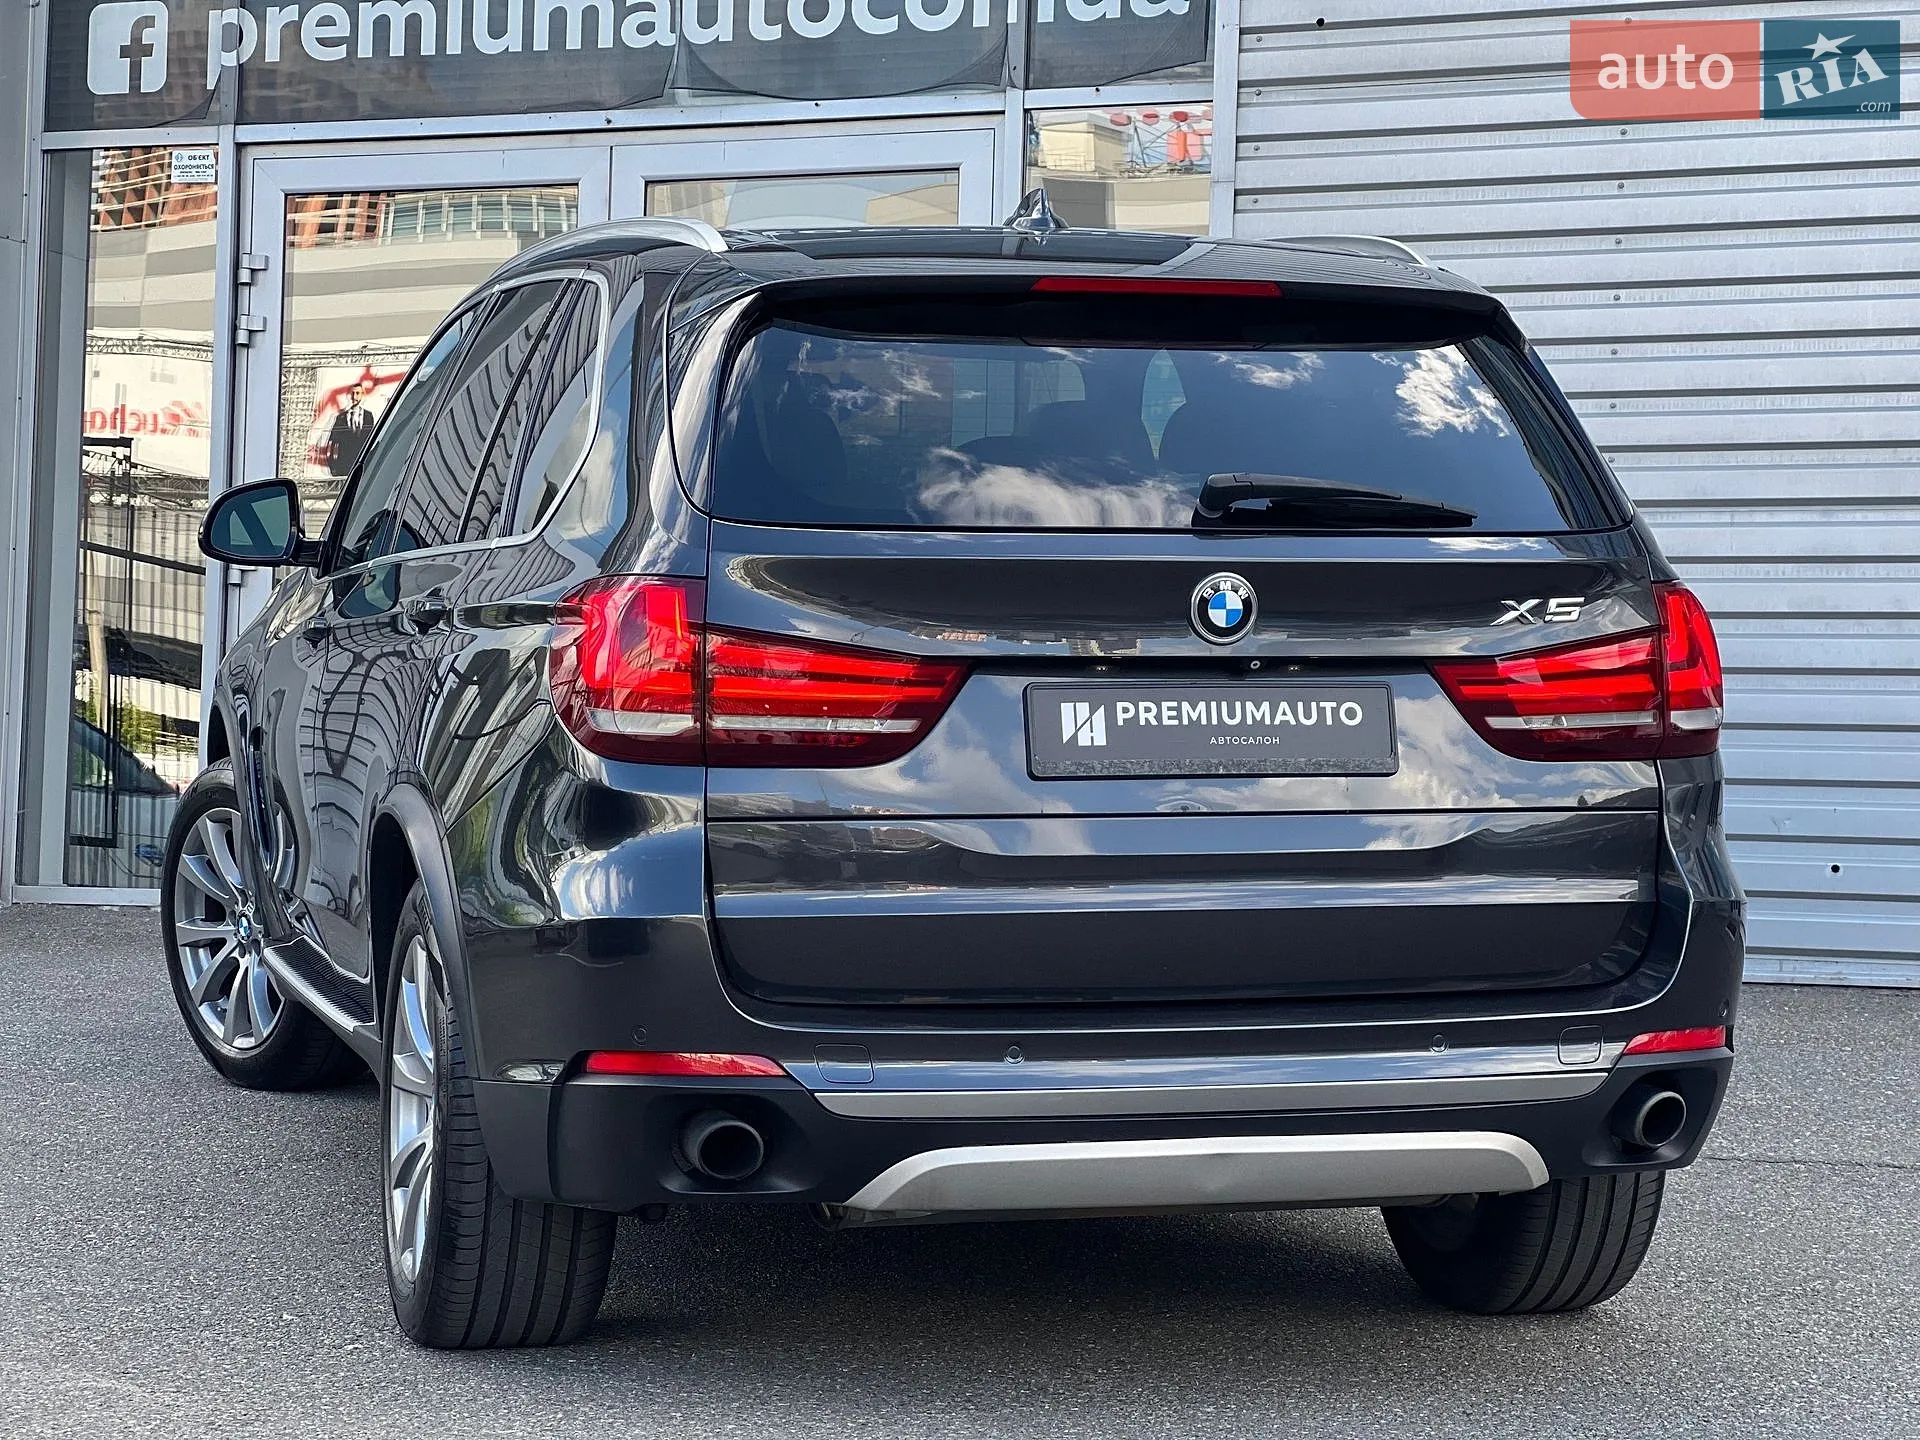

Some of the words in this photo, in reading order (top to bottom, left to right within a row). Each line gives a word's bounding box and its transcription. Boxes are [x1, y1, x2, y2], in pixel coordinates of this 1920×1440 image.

[1202, 580, 1249, 600] BMW
[1489, 597, 1585, 626] X5
[1116, 701, 1363, 727] PREMIUMAUTO
[1209, 736, 1280, 745] АВТОСАЛОН
